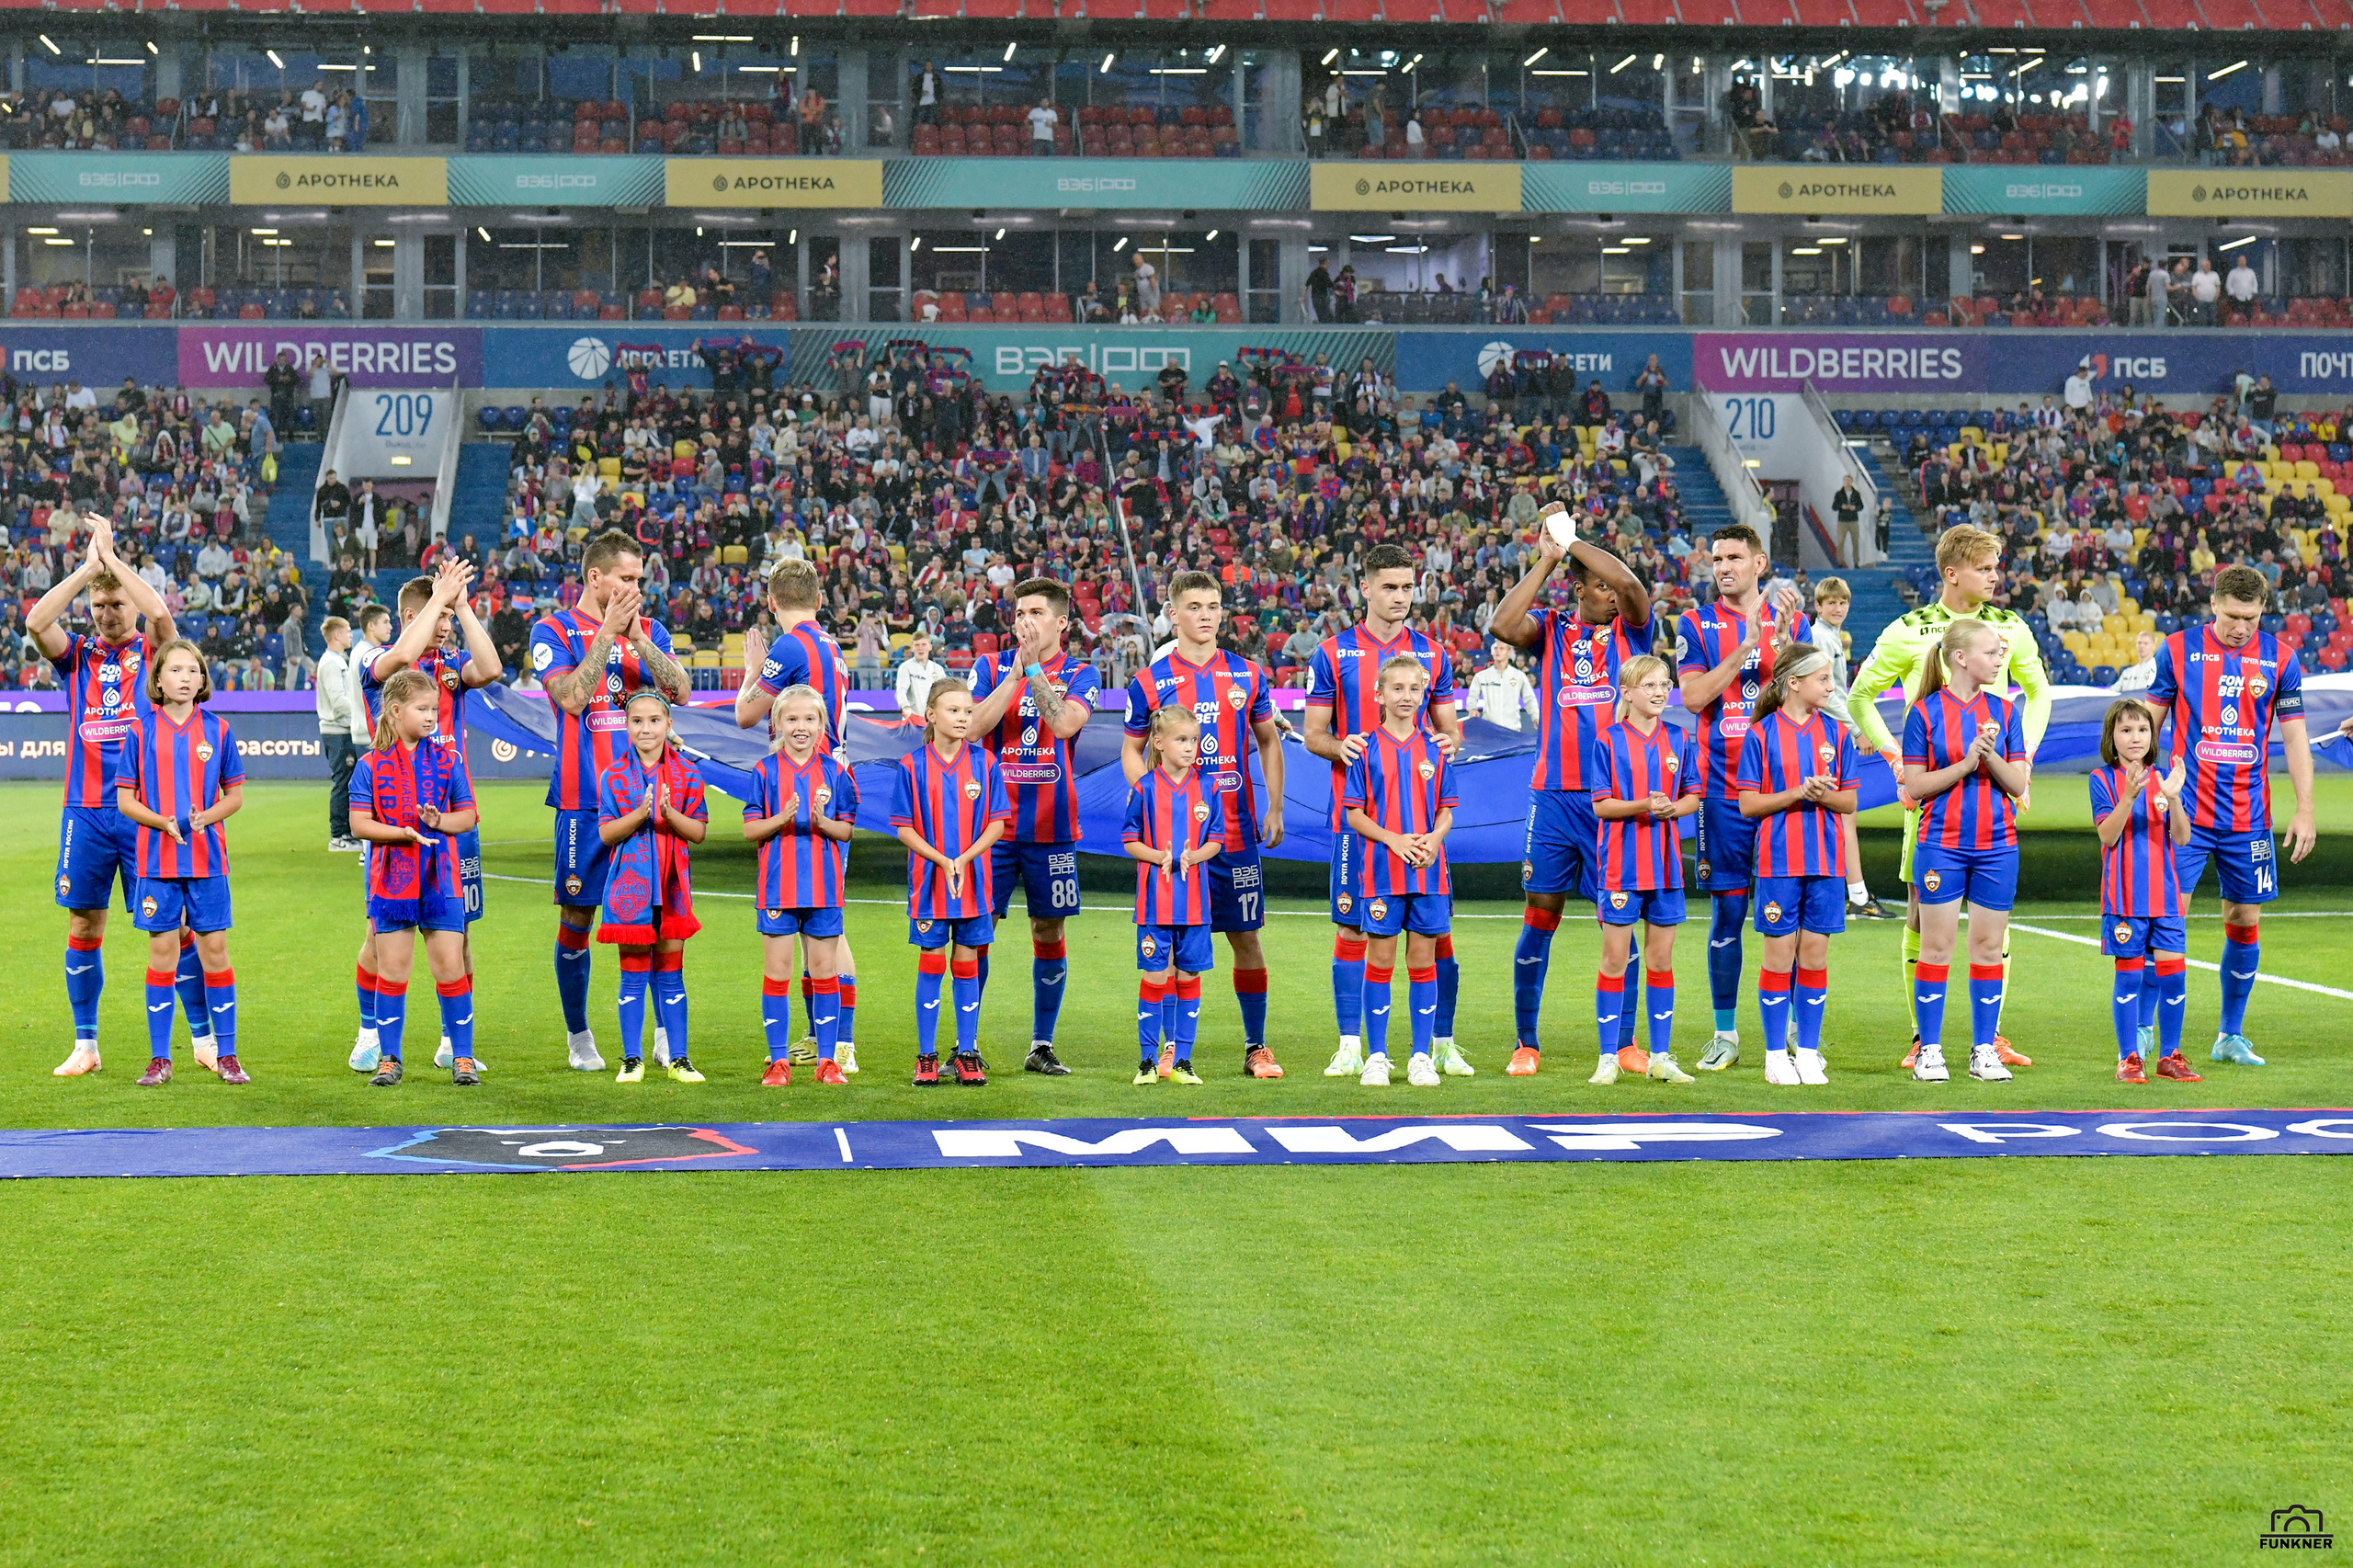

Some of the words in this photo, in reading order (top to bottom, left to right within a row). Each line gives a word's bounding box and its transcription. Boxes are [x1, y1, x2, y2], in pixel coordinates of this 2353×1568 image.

[297, 174, 399, 187] APOTHEKA
[733, 176, 835, 190] APOTHEKA
[1376, 180, 1475, 195] APOTHEKA
[1798, 184, 1896, 198] APOTHEKA
[2211, 187, 2309, 201] APOTHEKA
[13, 350, 70, 371] ПСБ
[1720, 347, 1963, 379] WILDBERRIES
[2114, 358, 2167, 378] ПСБ
[375, 394, 432, 436] 209
[1725, 398, 1775, 439] 210
[1711, 621, 1728, 630] ПСБ
[606, 653, 624, 665] ET
[1347, 649, 1366, 657] ПСБ
[2201, 653, 2221, 662] ПСБ
[765, 657, 782, 672] FON
[1741, 658, 1762, 670] ET
[2241, 656, 2259, 665] ПОЧТА
[1167, 676, 1186, 687] ПСБ
[2218, 675, 2245, 687] FON
[1563, 690, 1611, 701] WILDBERRIES
[2217, 686, 2245, 699] BET
[1193, 701, 1221, 712] FON
[2279, 698, 2301, 707] RESPECT
[591, 714, 628, 726] WILDBE
[1196, 711, 1221, 724] BET
[85, 724, 131, 736] WILDBERRI
[2200, 725, 2256, 737] APOTHEKA
[20, 741, 66, 759] для
[235, 740, 321, 756] расоты
[1001, 746, 1055, 756] APOTHEKA
[2200, 746, 2254, 759] WILDBERRIES
[1192, 755, 1237, 766] OTHEKA
[1002, 768, 1056, 778] WILDBERRIES
[401, 778, 415, 828] НАВСЕГ
[569, 819, 577, 845] РОССИИ
[1342, 835, 1350, 861] РОССИИ
[1048, 852, 1074, 864] ВЭБ
[1232, 865, 1259, 878] ВЭБ
[1340, 862, 1348, 885] ПОЧТА
[2254, 865, 2273, 894] 14
[462, 884, 480, 914] 10
[1051, 879, 1078, 909] 88
[1237, 891, 1258, 923] 17
[931, 1123, 1784, 1157] МИР
